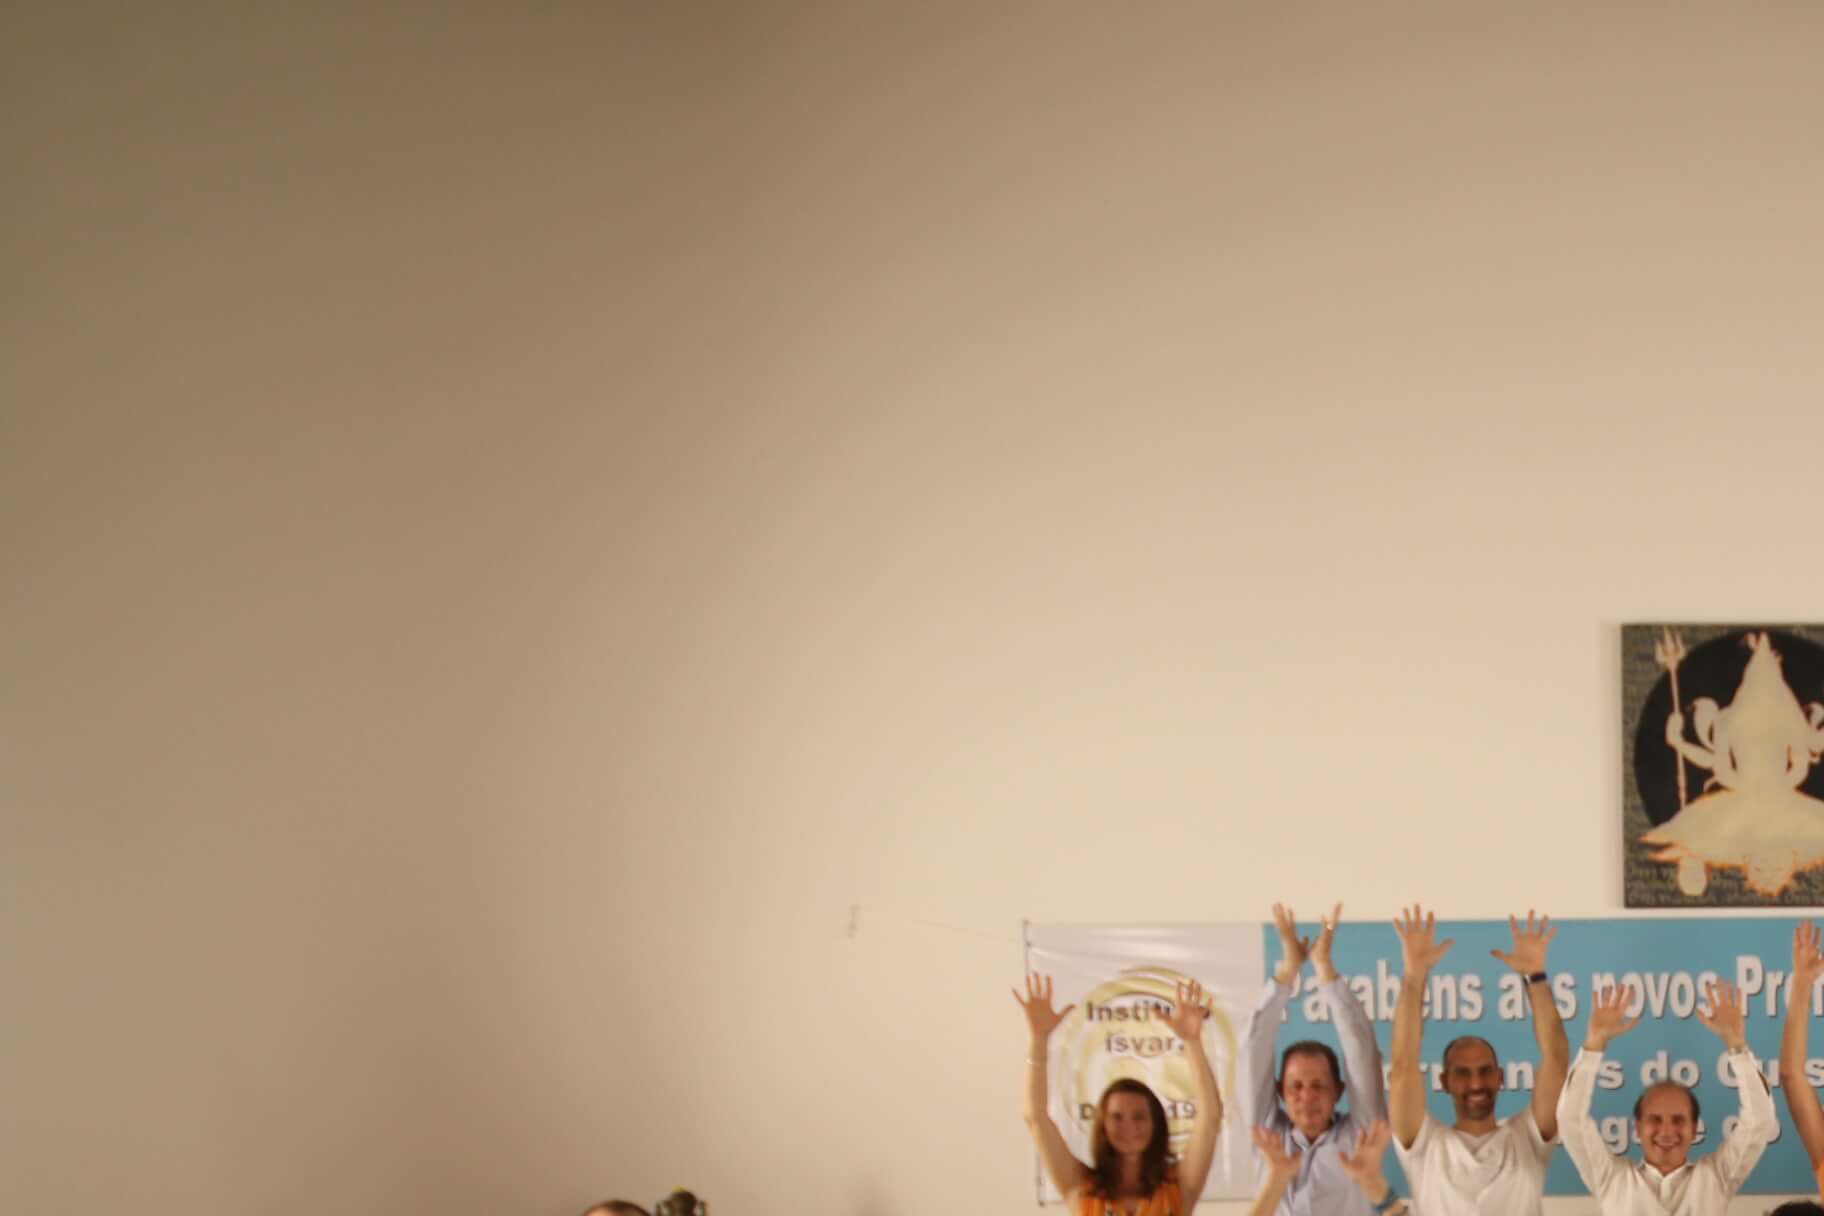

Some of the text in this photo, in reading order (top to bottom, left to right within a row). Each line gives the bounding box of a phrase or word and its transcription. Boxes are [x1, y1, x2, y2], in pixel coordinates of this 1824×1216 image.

[1274, 957, 1484, 1022] aabns
[1498, 970, 1577, 1020] as
[1640, 1049, 1700, 1089] do
